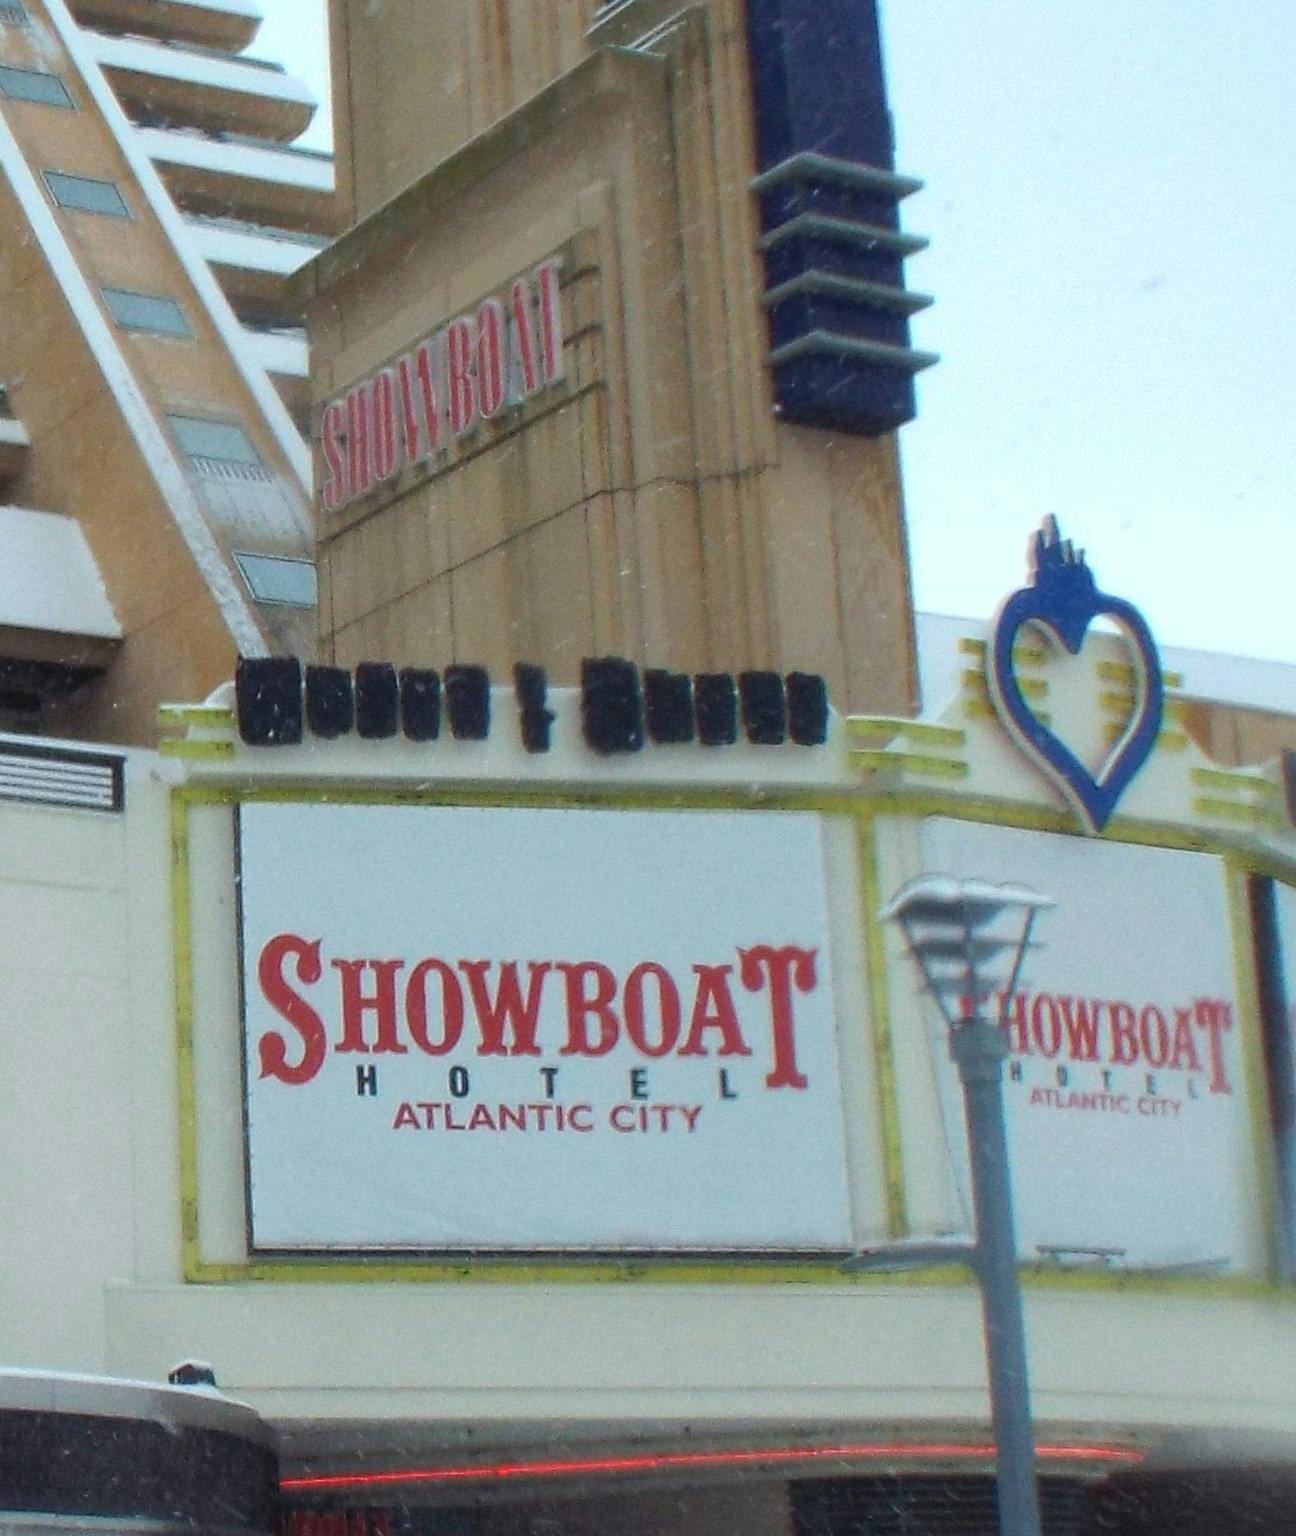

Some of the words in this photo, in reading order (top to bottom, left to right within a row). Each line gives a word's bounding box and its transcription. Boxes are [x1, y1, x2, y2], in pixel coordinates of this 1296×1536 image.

[257, 933, 818, 1089] SHOWBOAT
[356, 1065, 738, 1100] HOTEL
[1010, 1061, 1198, 1100] HOTEL
[392, 1102, 594, 1133] ATLANTIC
[608, 1103, 703, 1134] CITY
[1029, 1087, 1130, 1115] ATLANTIC
[1136, 1095, 1183, 1117] CITY
